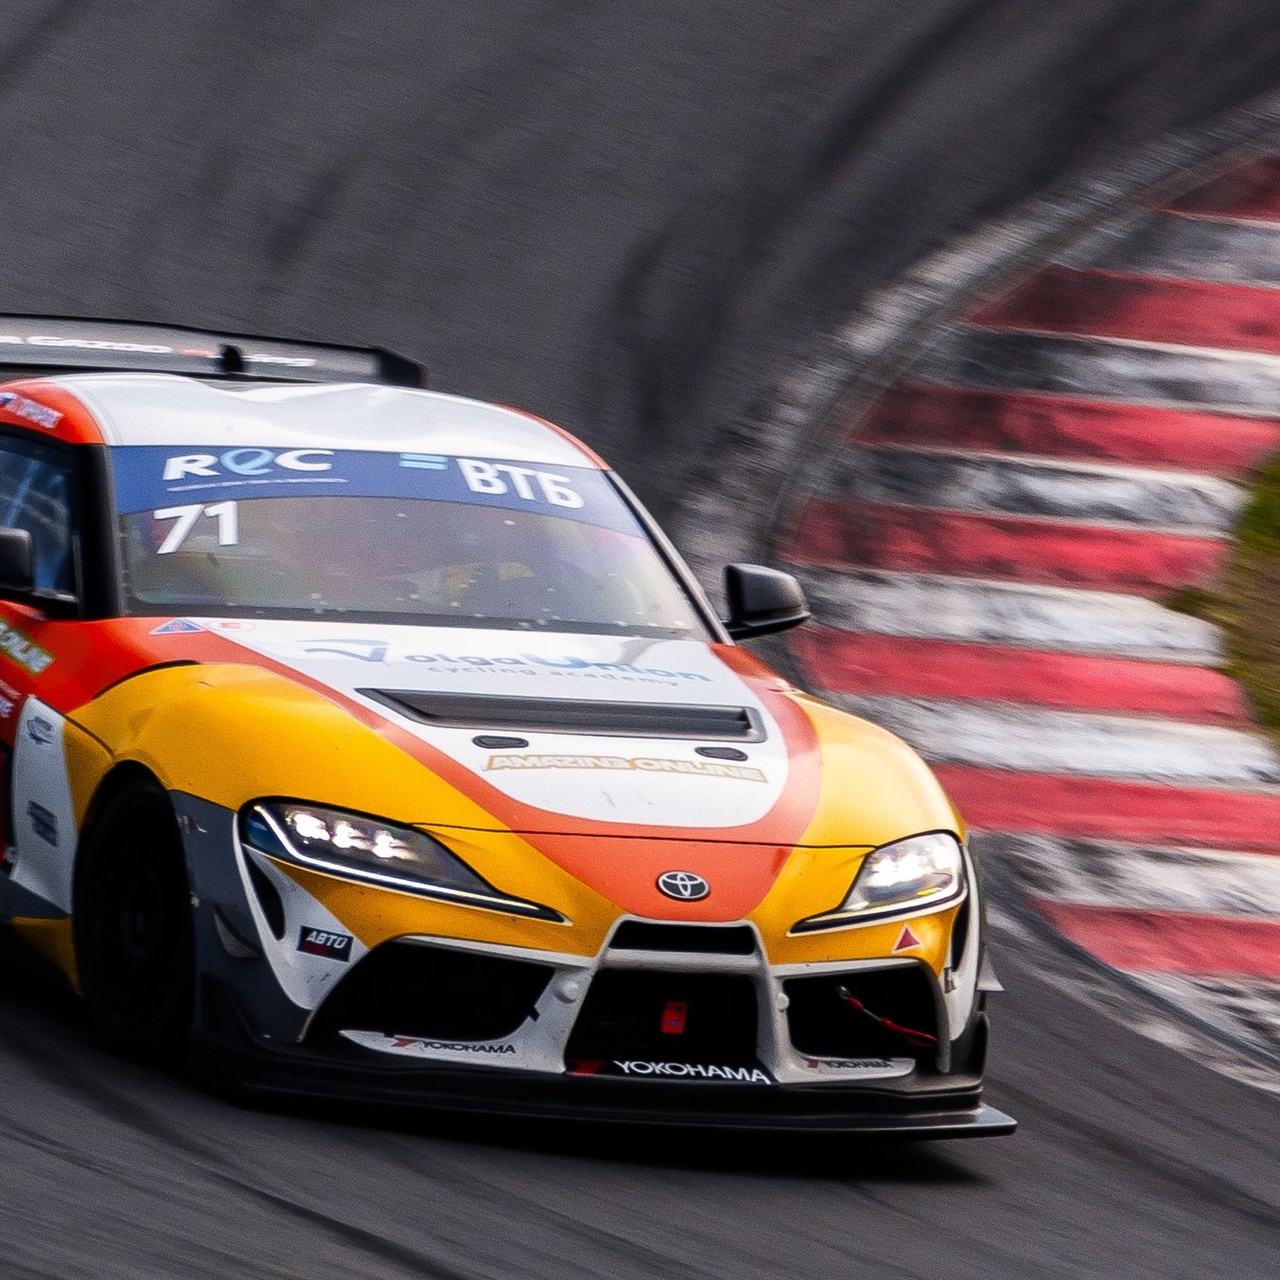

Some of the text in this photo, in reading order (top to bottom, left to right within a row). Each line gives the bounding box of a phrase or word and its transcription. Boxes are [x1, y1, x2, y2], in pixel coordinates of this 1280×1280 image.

[153, 500, 239, 555] 71
[428, 664, 681, 687] cycling academy
[422, 1040, 516, 1054] YOKOHAMA
[613, 1060, 771, 1084] YOKOHAMA
